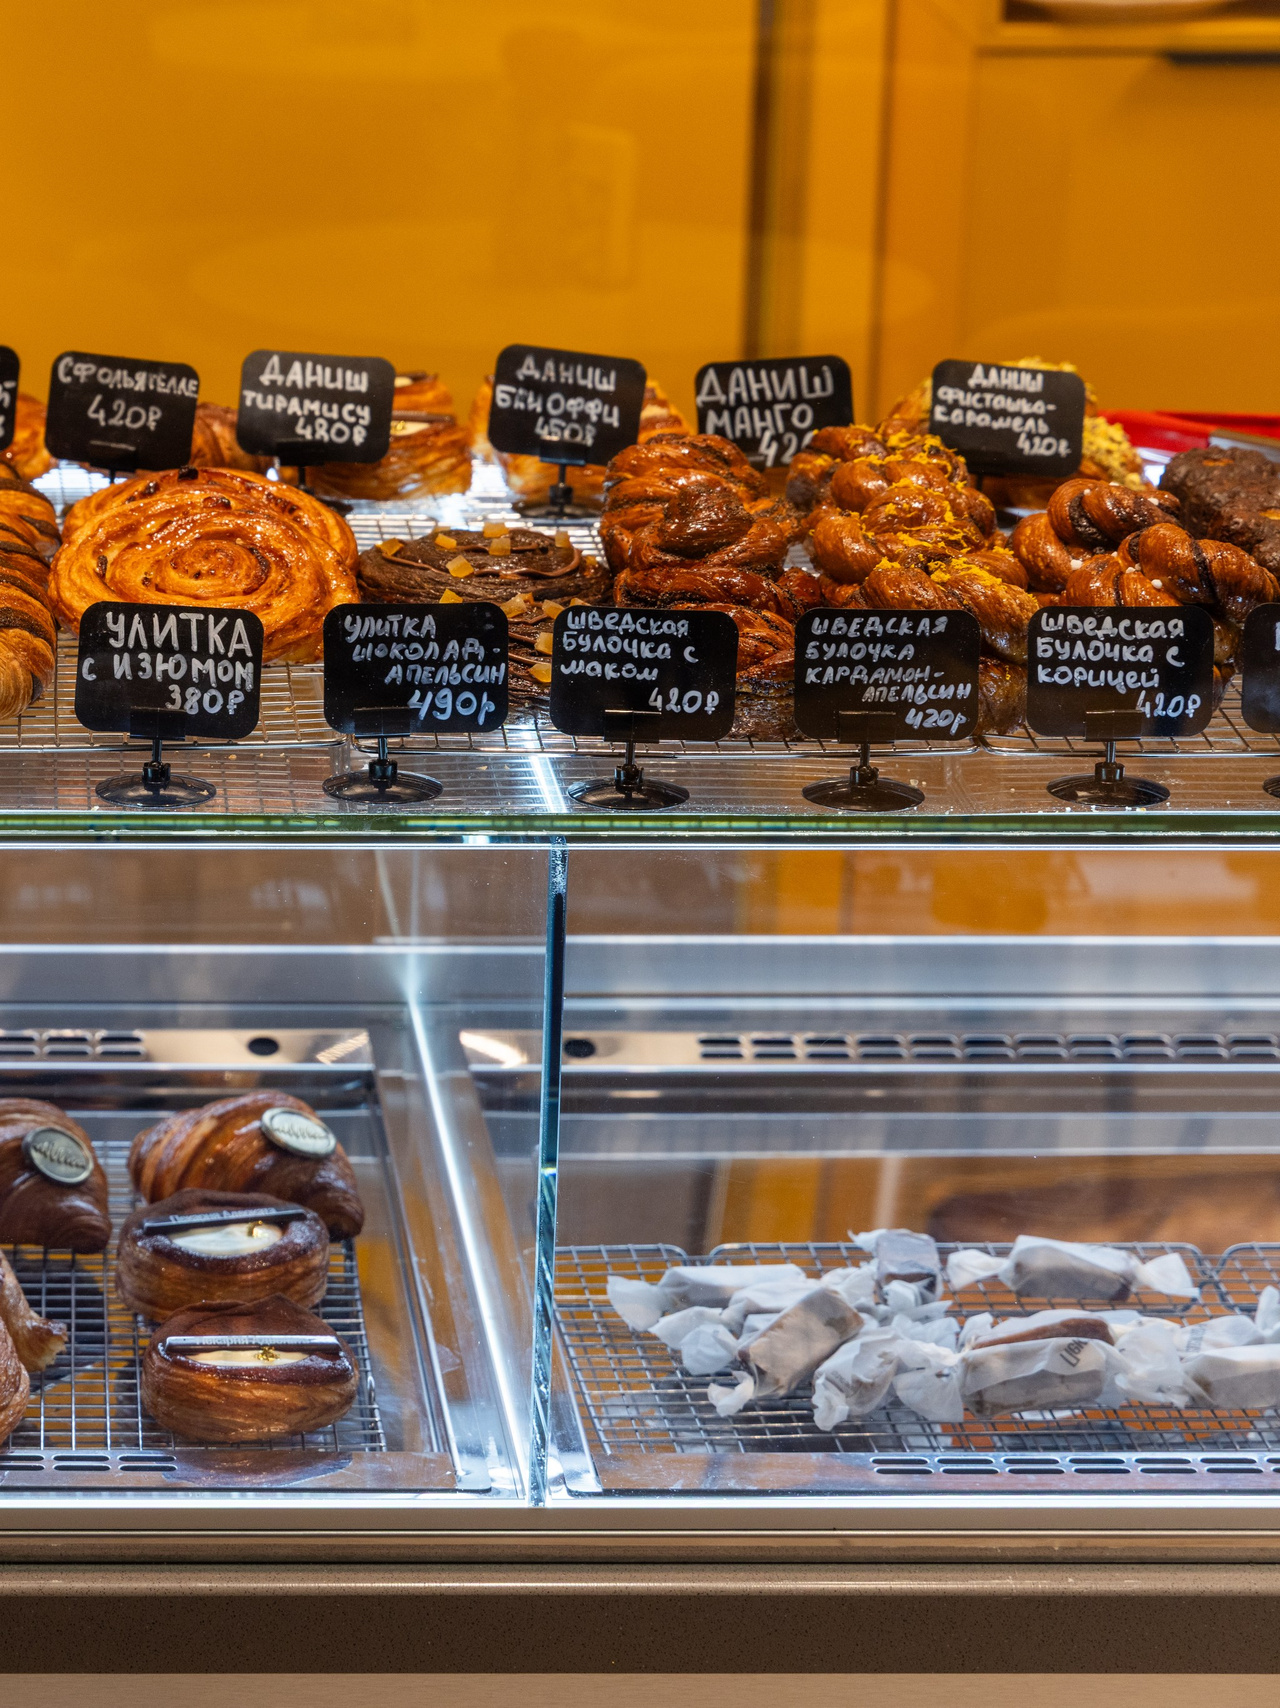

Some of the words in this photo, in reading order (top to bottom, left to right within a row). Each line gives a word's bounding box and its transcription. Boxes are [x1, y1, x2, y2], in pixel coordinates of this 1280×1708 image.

[259, 354, 369, 393] ДАНИШ
[516, 354, 617, 392] ДАНИШ
[696, 365, 834, 407] ДАНИШ
[967, 363, 1044, 393] ДАНИШ
[242, 390, 371, 426] ТИРАМИСУ
[705, 402, 814, 439] МАНГО
[106, 611, 253, 658] УЛИТКА
[344, 614, 437, 643] УЛИТКА
[811, 616, 949, 638] ШВЕДСКАЯ
[805, 640, 915, 663] БУЛОЧКА
[113, 652, 254, 692] ИЗЮМОМ
[384, 662, 506, 686] АПЕЛЬСИН
[861, 682, 972, 705] АПЕЛЬСИН
